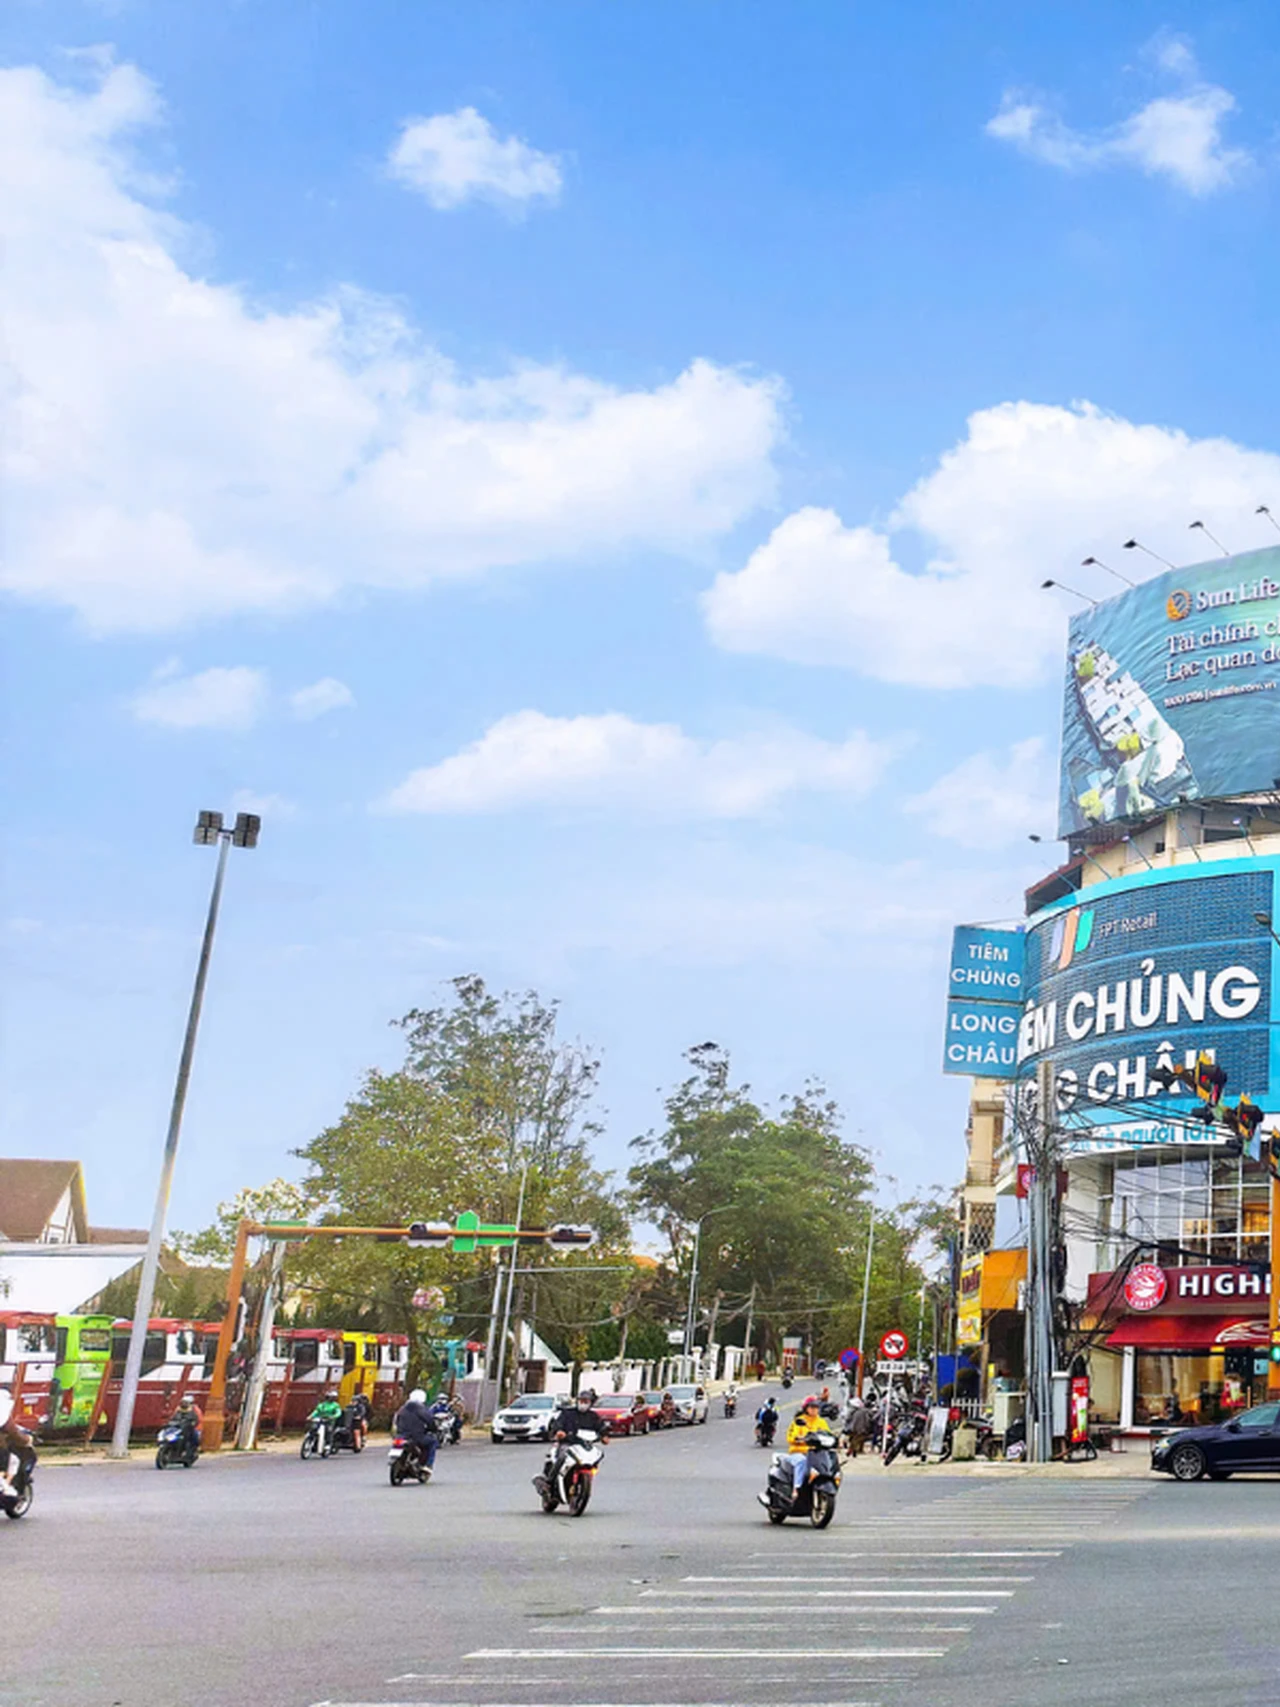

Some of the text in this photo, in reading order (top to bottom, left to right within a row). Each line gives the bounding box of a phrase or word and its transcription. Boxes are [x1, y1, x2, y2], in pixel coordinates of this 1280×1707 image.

[1196, 576, 1280, 611] Sun Life
[1204, 650, 1257, 677] quan
[968, 942, 1010, 961] TIÊM
[951, 964, 1022, 988] CHỦNG
[1065, 957, 1262, 1041] CHỦNG
[951, 1012, 1017, 1035] LONG
[947, 1040, 1016, 1065] CHÂU
